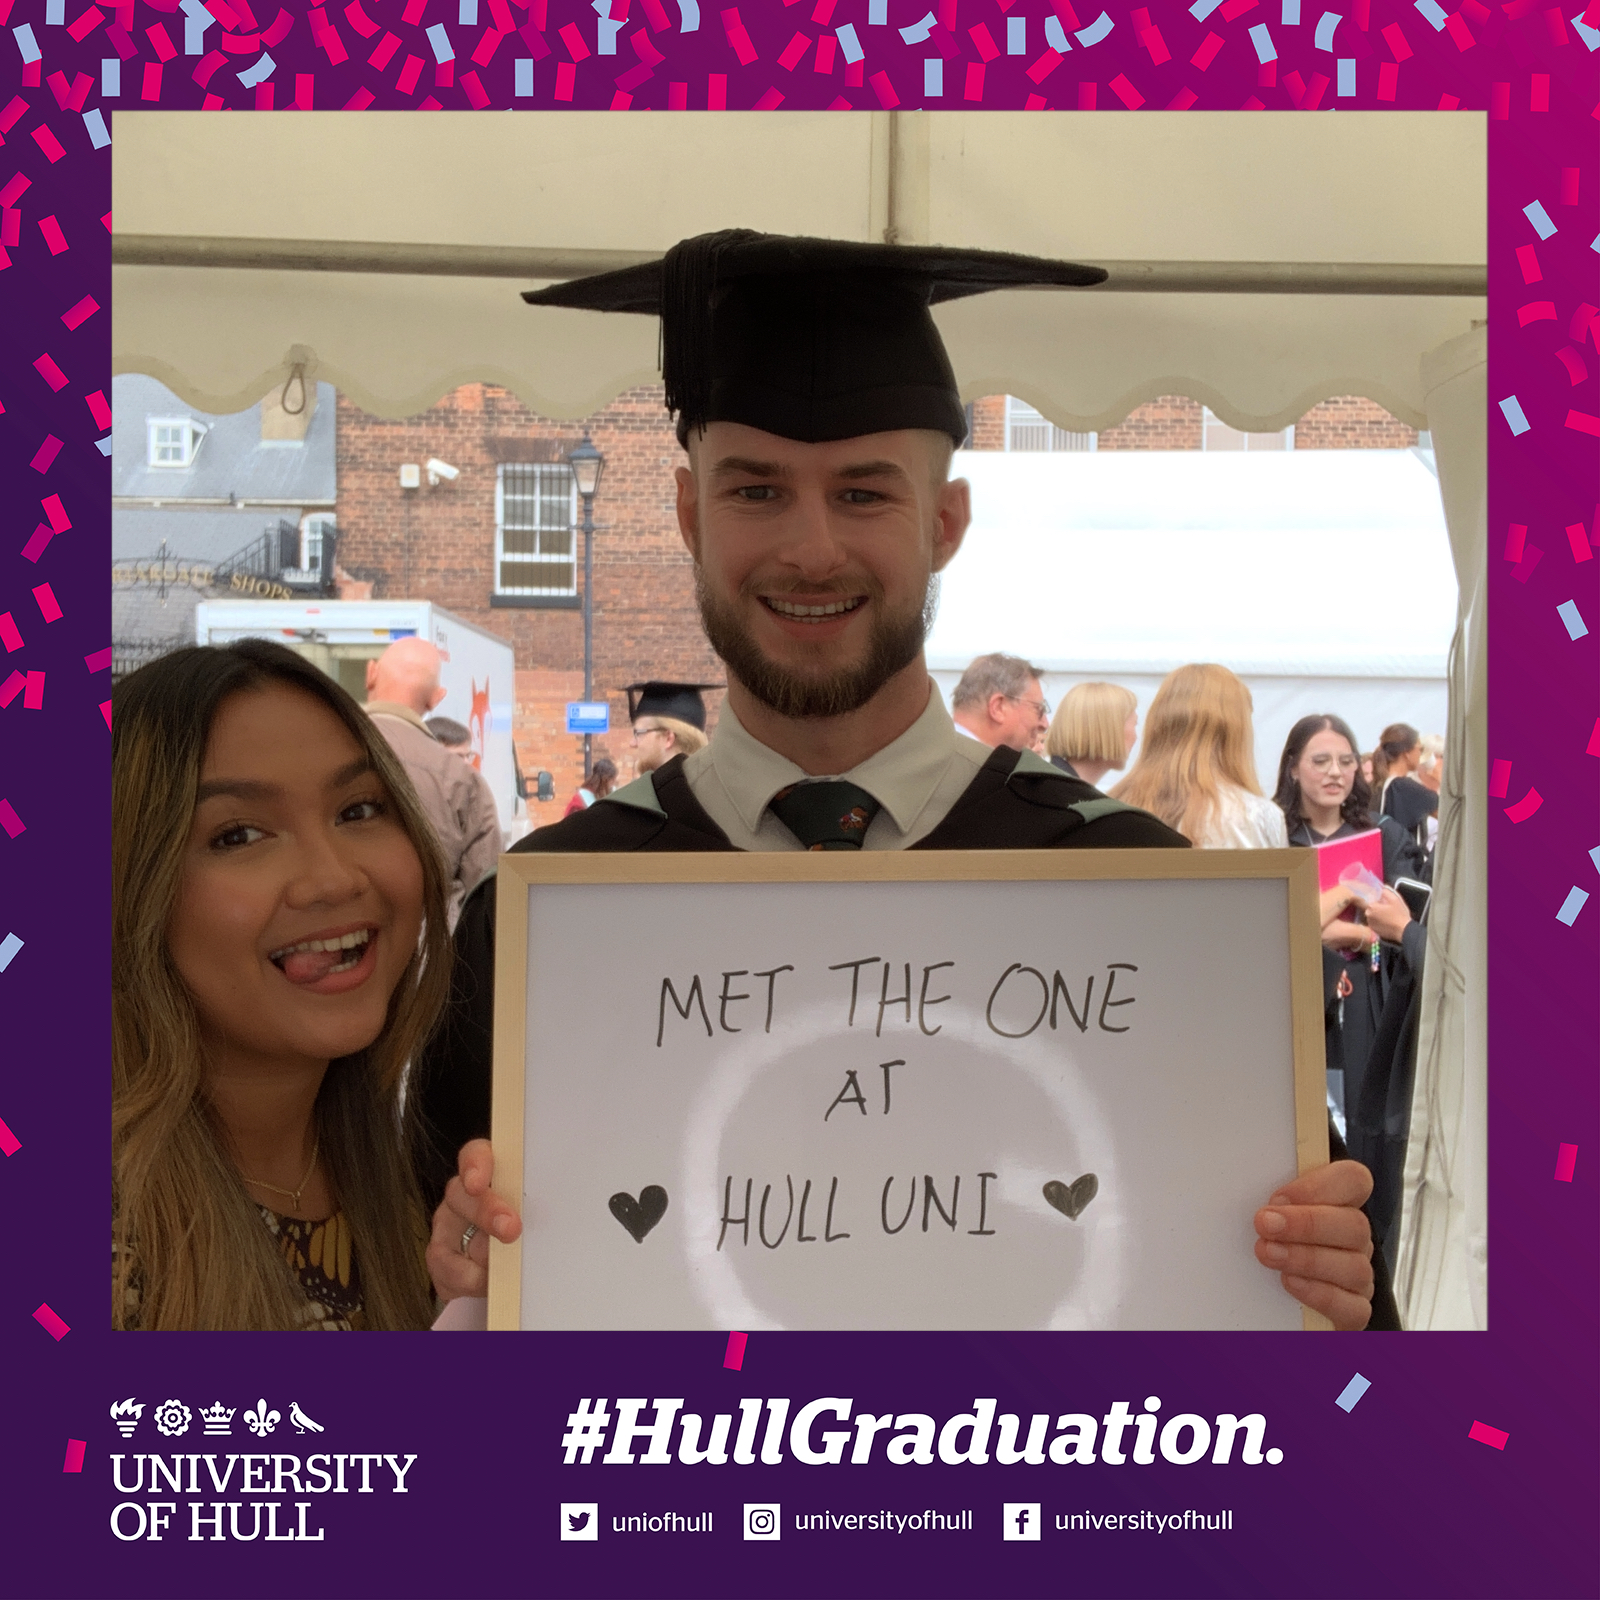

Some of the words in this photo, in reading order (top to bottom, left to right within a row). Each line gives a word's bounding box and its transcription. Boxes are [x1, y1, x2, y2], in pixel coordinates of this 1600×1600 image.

[231, 572, 293, 602] SHOPS
[656, 964, 795, 1048] MET
[828, 956, 955, 1038] THE
[986, 962, 1139, 1038] ONE
[824, 1059, 906, 1122] AT
[716, 1174, 851, 1251] HULL
[881, 1172, 998, 1236] UNI
